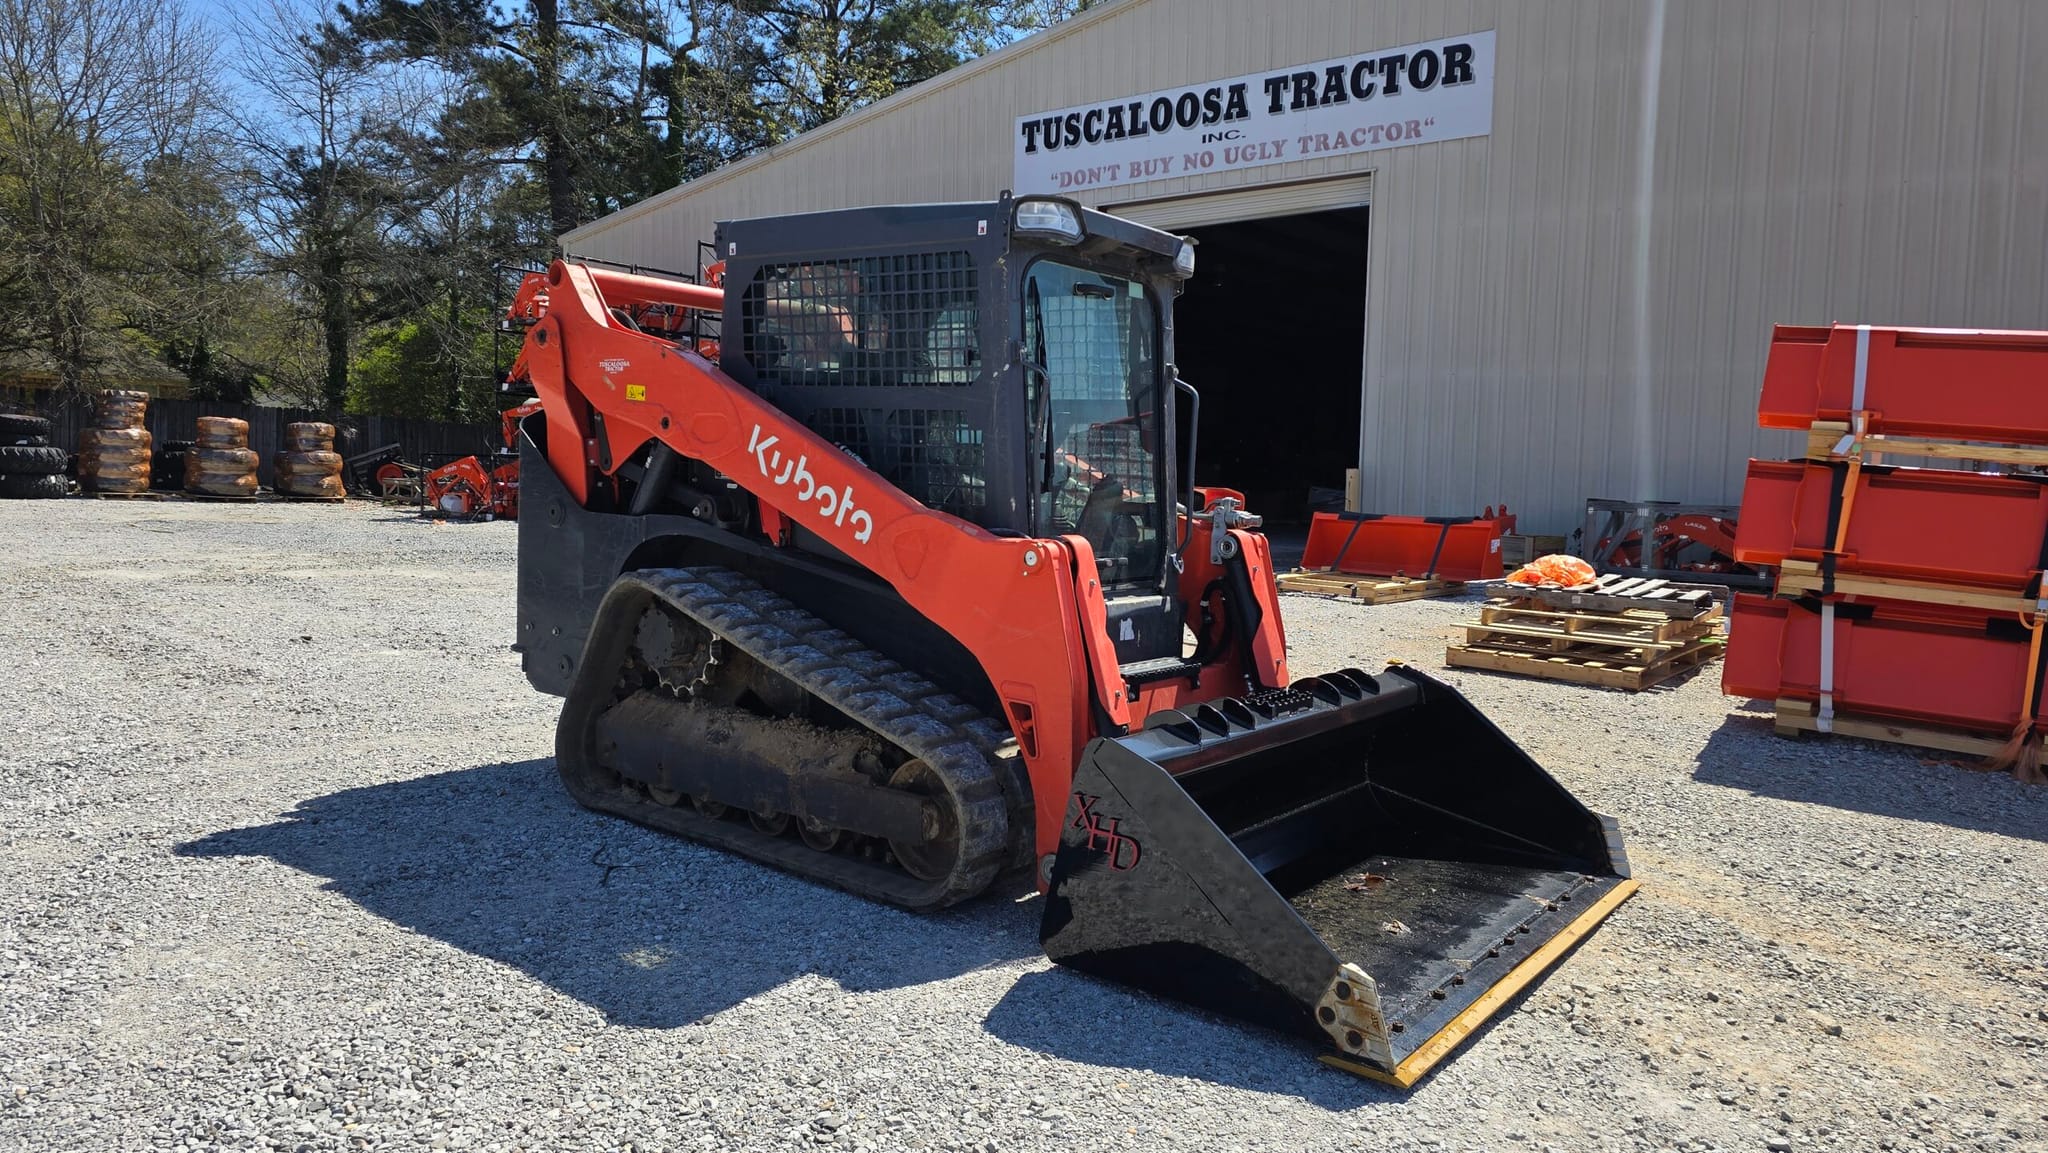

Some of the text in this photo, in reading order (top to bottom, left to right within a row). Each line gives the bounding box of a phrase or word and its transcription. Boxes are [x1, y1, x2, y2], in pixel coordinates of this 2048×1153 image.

[1022, 43, 1475, 153] TUSCALOOSA TRACTOR
[1202, 129, 1246, 144] INC.
[1129, 156, 1173, 178] BUY
[1184, 150, 1214, 171] NO
[1224, 139, 1288, 164] UGLY
[747, 424, 873, 545] Kubota
[1070, 791, 1142, 873] XHD
